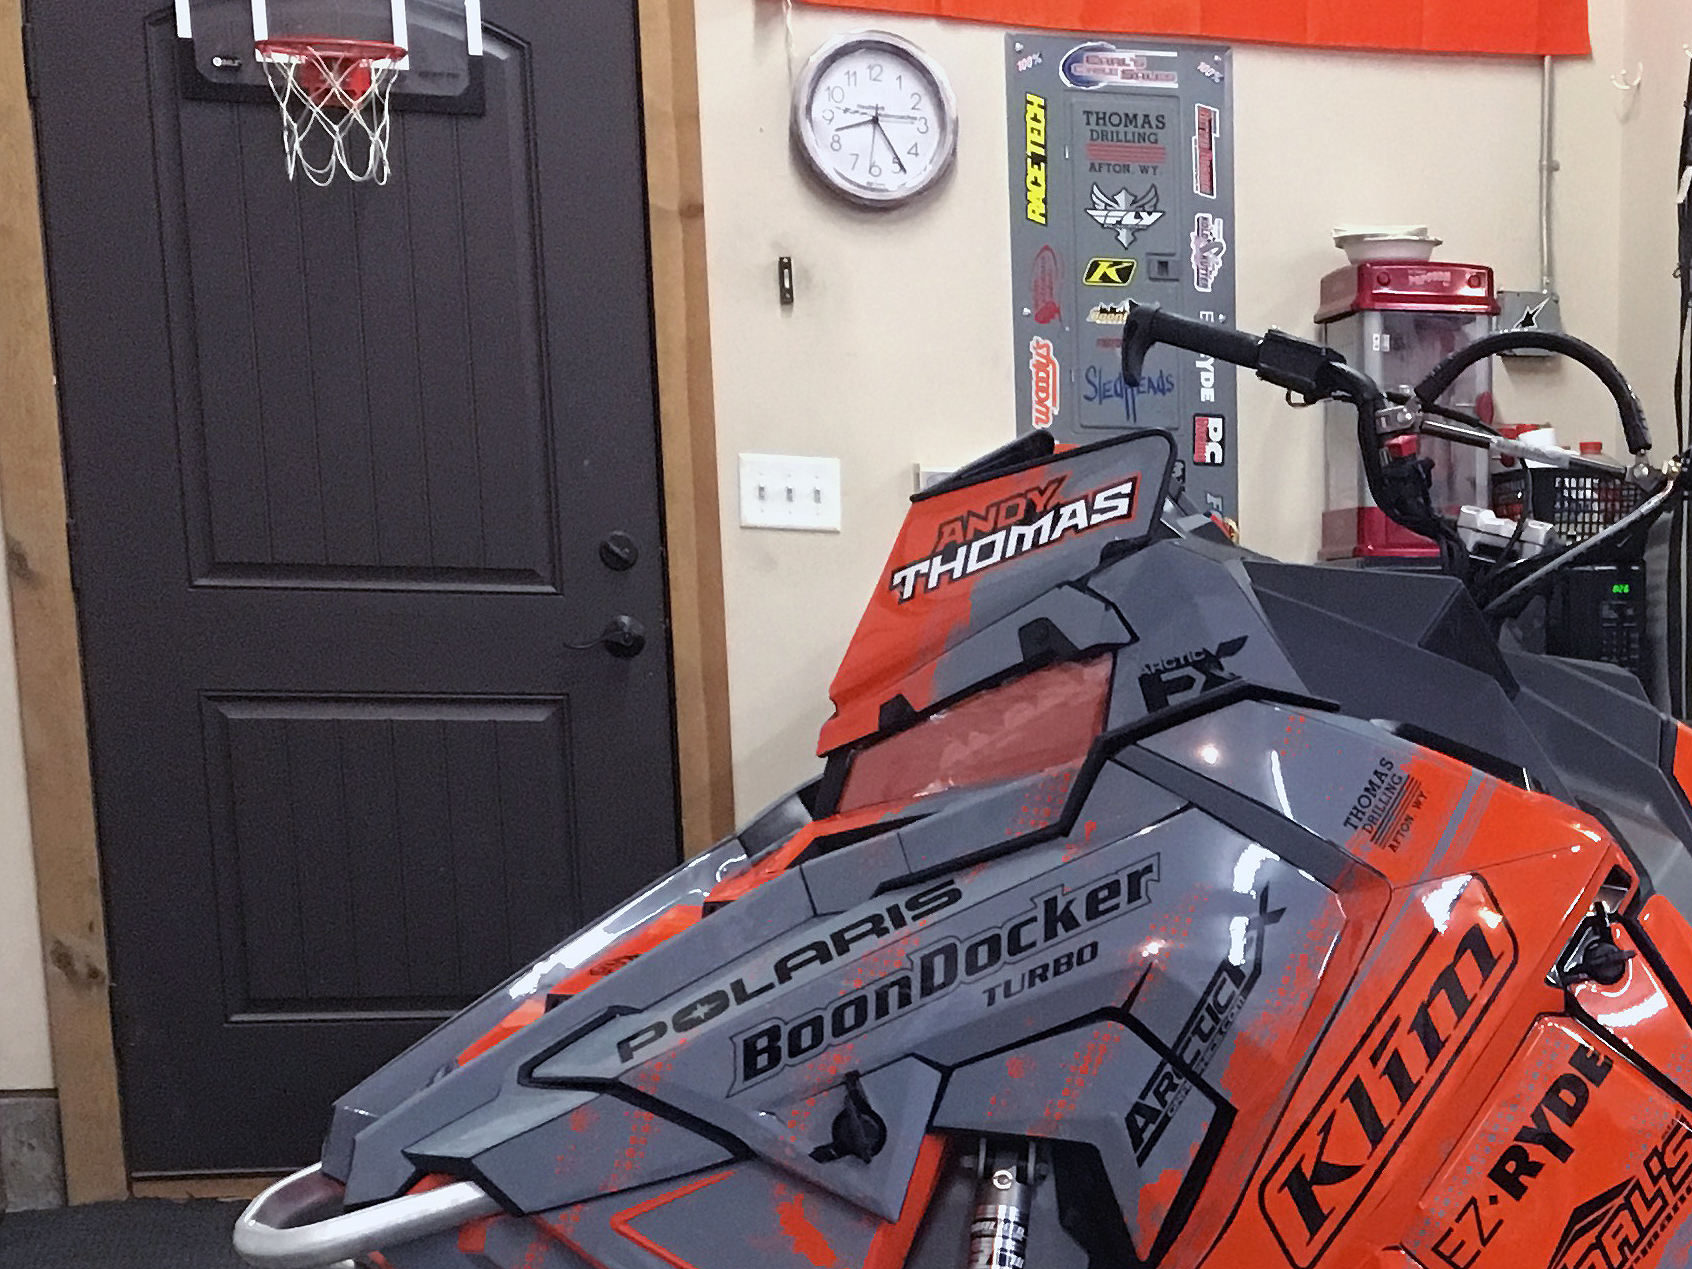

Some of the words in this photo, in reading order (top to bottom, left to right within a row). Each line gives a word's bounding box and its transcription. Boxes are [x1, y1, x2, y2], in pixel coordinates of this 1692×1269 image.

[844, 70, 858, 87] 11
[866, 64, 884, 82] 12
[895, 75, 903, 90] 1
[824, 86, 845, 104] 10
[910, 92, 923, 111] 2
[822, 109, 835, 125] 9
[916, 116, 929, 135] 3
[1082, 110, 1167, 130] THOMAS
[830, 134, 842, 152] 8
[1089, 128, 1159, 145] DRILLING
[907, 142, 920, 158] 4
[849, 153, 860, 171] 7
[869, 159, 882, 178] 6
[891, 157, 905, 175] 5
[1086, 209, 1165, 226] FLY
[1204, 417, 1223, 464] PC
[933, 475, 1068, 552] ANDY
[892, 477, 1140, 604] THOMAS
[1343, 757, 1394, 831] THOMAS
[1362, 773, 1403, 834] DRILLING
[1387, 814, 1414, 853] AFTON
[1411, 791, 1428, 810] WY
[616, 879, 963, 1065] POLARIS
[738, 858, 1158, 1086] BoonDocker
[982, 940, 1099, 1007] TURBO
